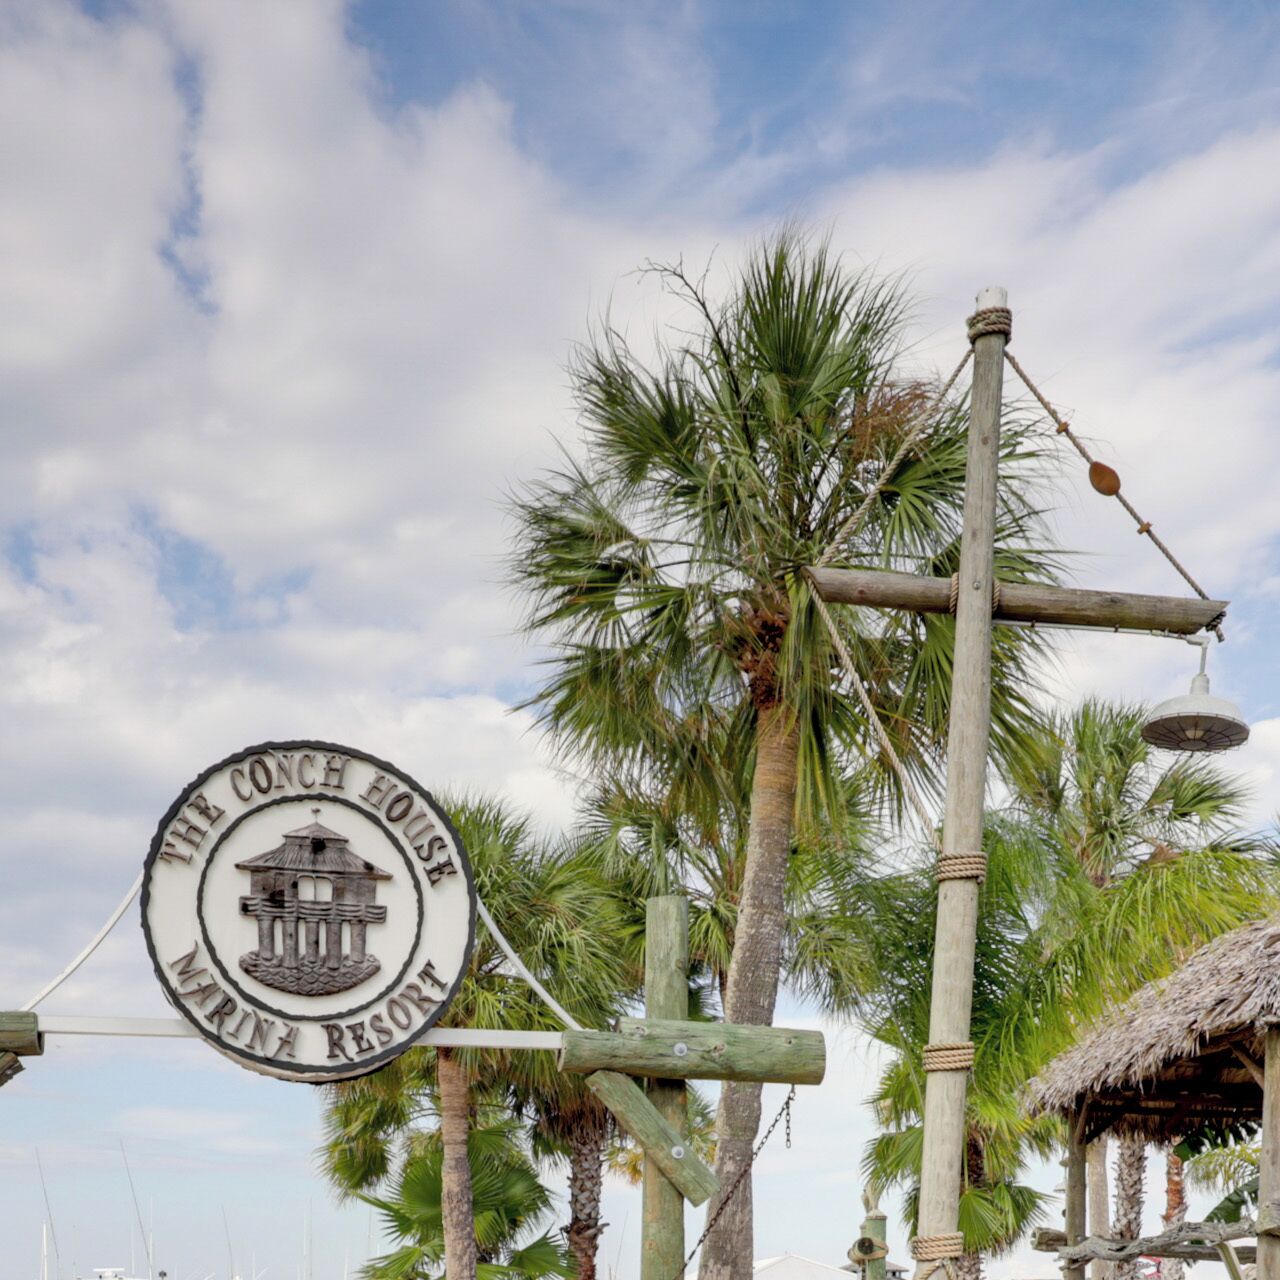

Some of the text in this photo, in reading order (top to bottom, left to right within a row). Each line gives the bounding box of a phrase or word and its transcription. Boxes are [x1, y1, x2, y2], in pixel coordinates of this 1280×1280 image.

[159, 750, 459, 888] THE CONCH HOUSE
[167, 940, 449, 1062] MARINA RESORT
